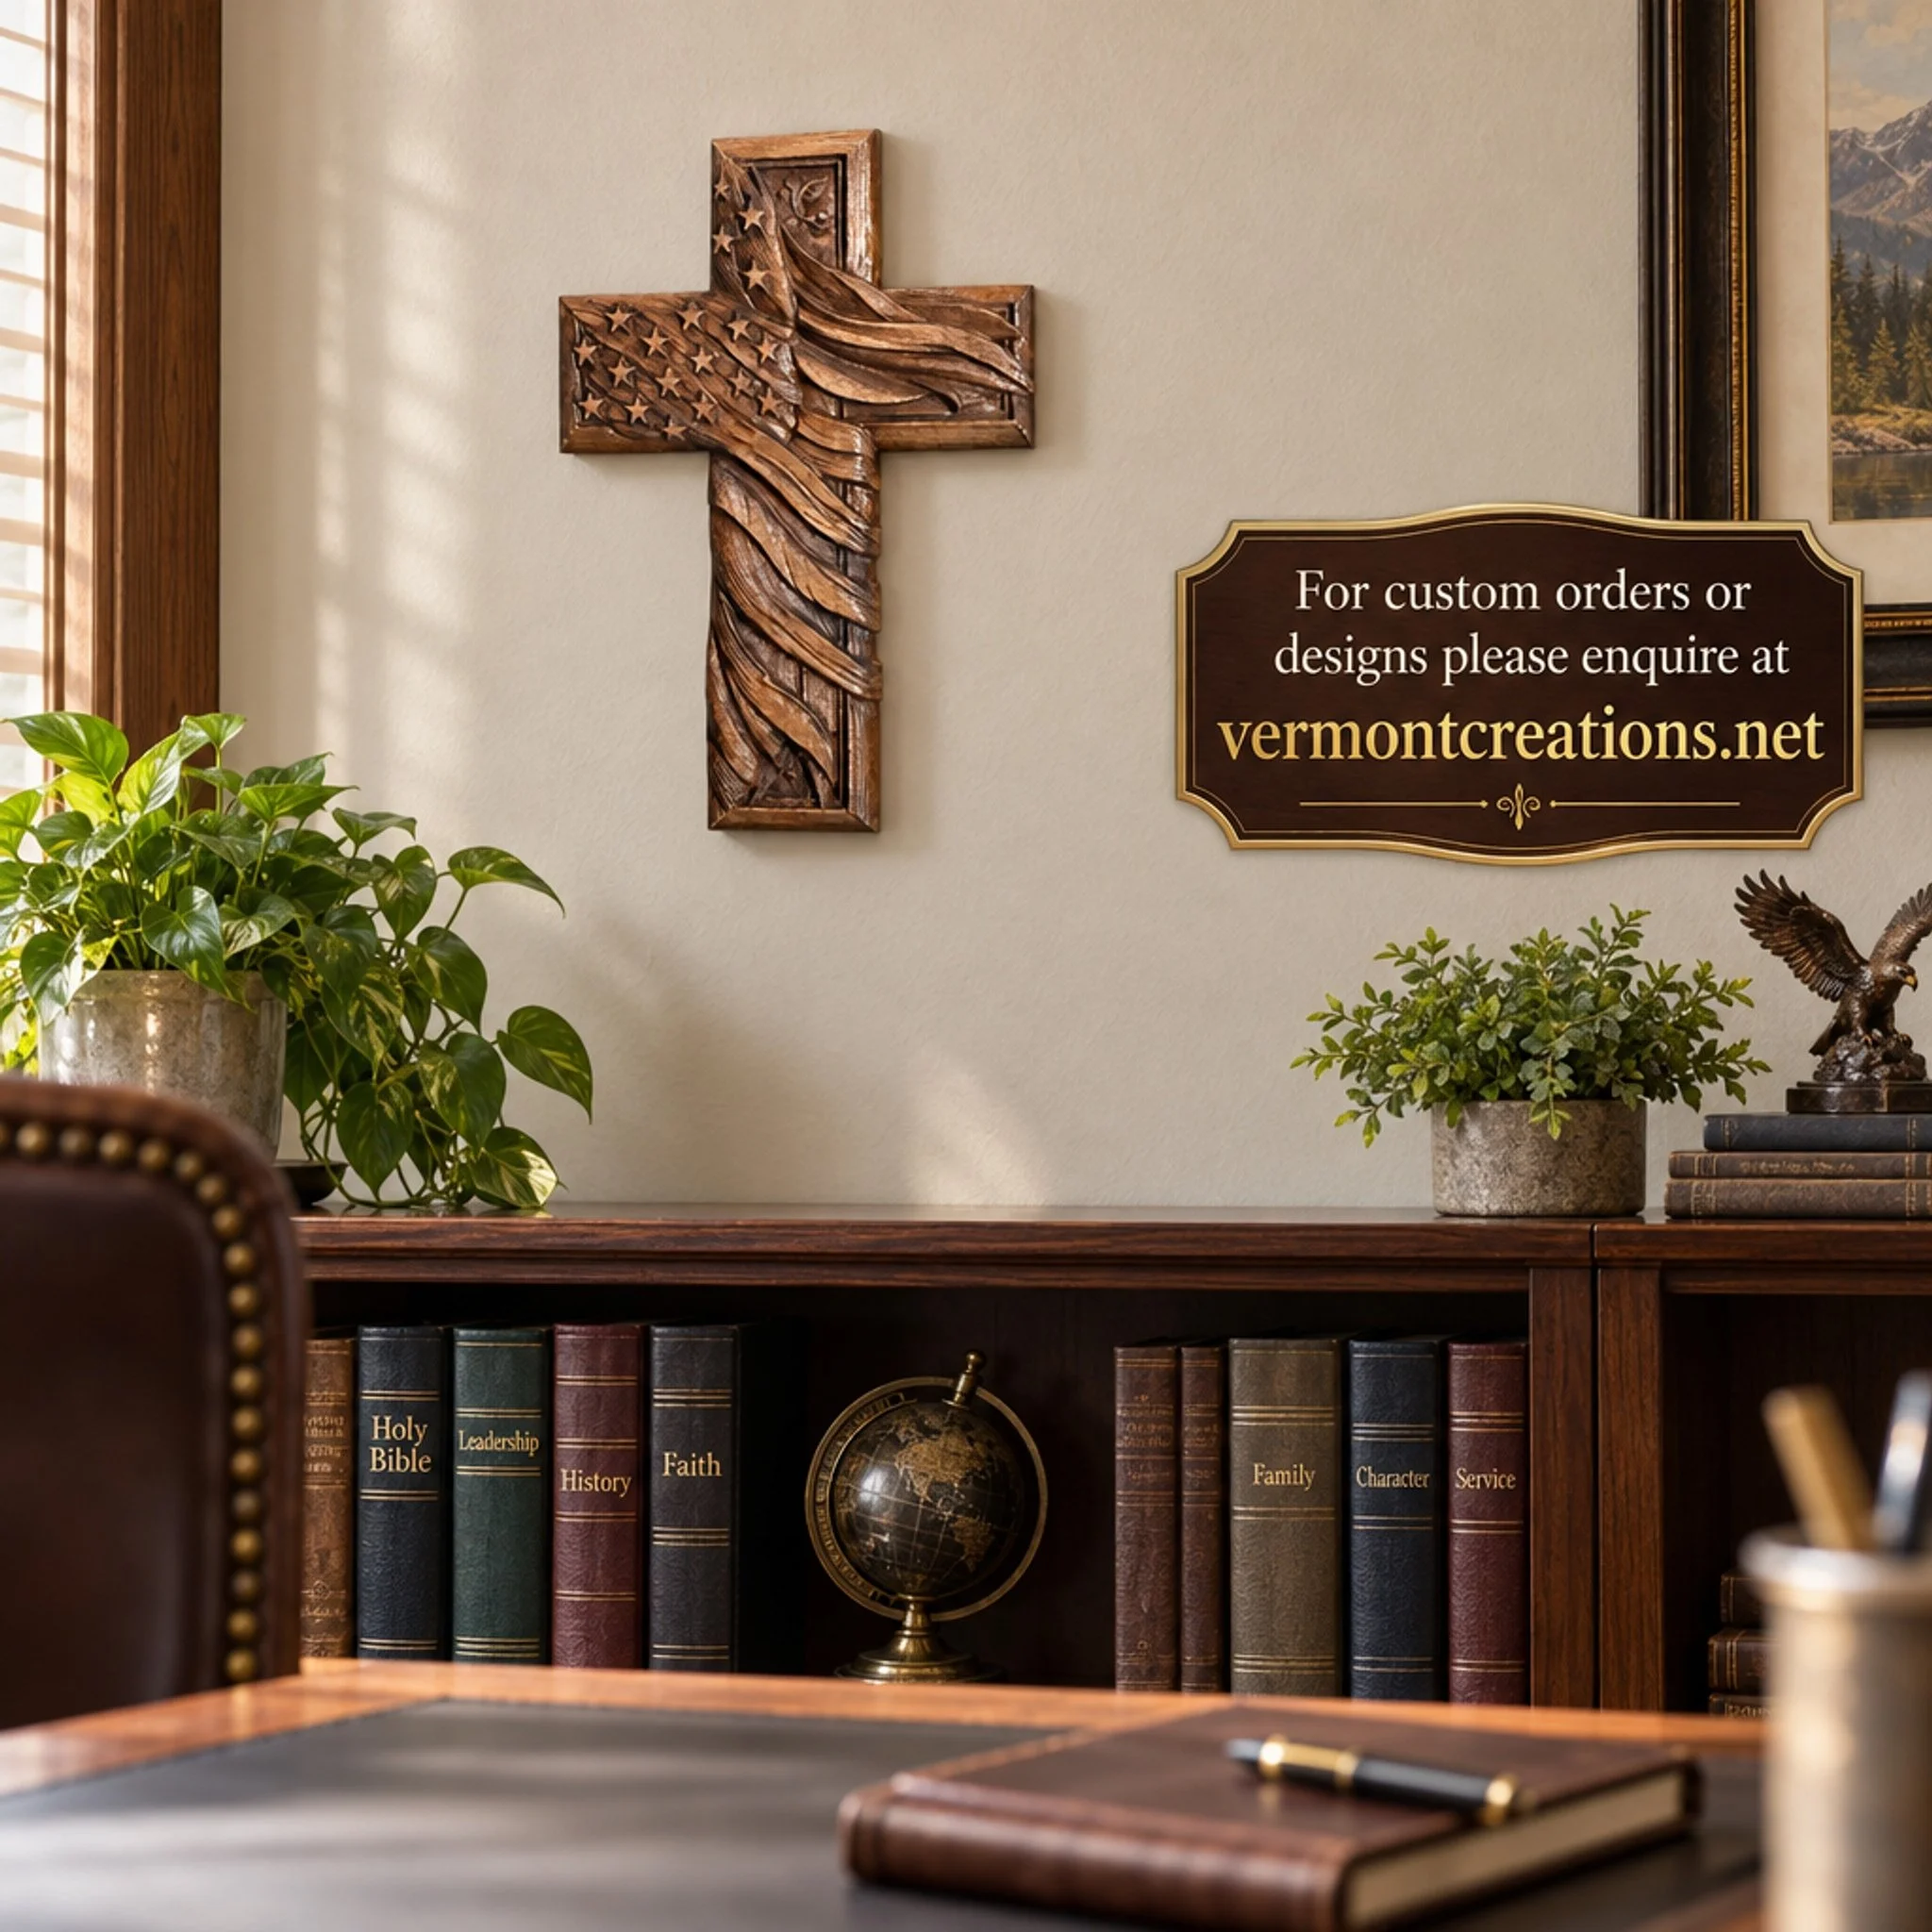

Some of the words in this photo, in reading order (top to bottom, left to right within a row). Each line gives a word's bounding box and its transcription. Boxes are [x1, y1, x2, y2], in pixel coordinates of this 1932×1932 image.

[1296, 570, 1370, 610] For
[1384, 576, 1541, 610] custom
[1556, 567, 1690, 610] orders
[1706, 582, 1752, 610] or
[1274, 631, 1427, 687] designs
[1442, 631, 1569, 687] please
[1582, 634, 1739, 687] enquire
[1752, 641, 1790, 675] at
[1217, 705, 1824, 760] vermontcreations.net
[372, 1416, 427, 1445] Holy
[458, 1430, 539, 1457] Leadership
[370, 1443, 431, 1473] Bible
[662, 1452, 721, 1477] Faith
[559, 1468, 631, 1497] History
[1253, 1463, 1316, 1491] Family
[1356, 1465, 1429, 1488] Character
[1454, 1467, 1515, 1490] Service
